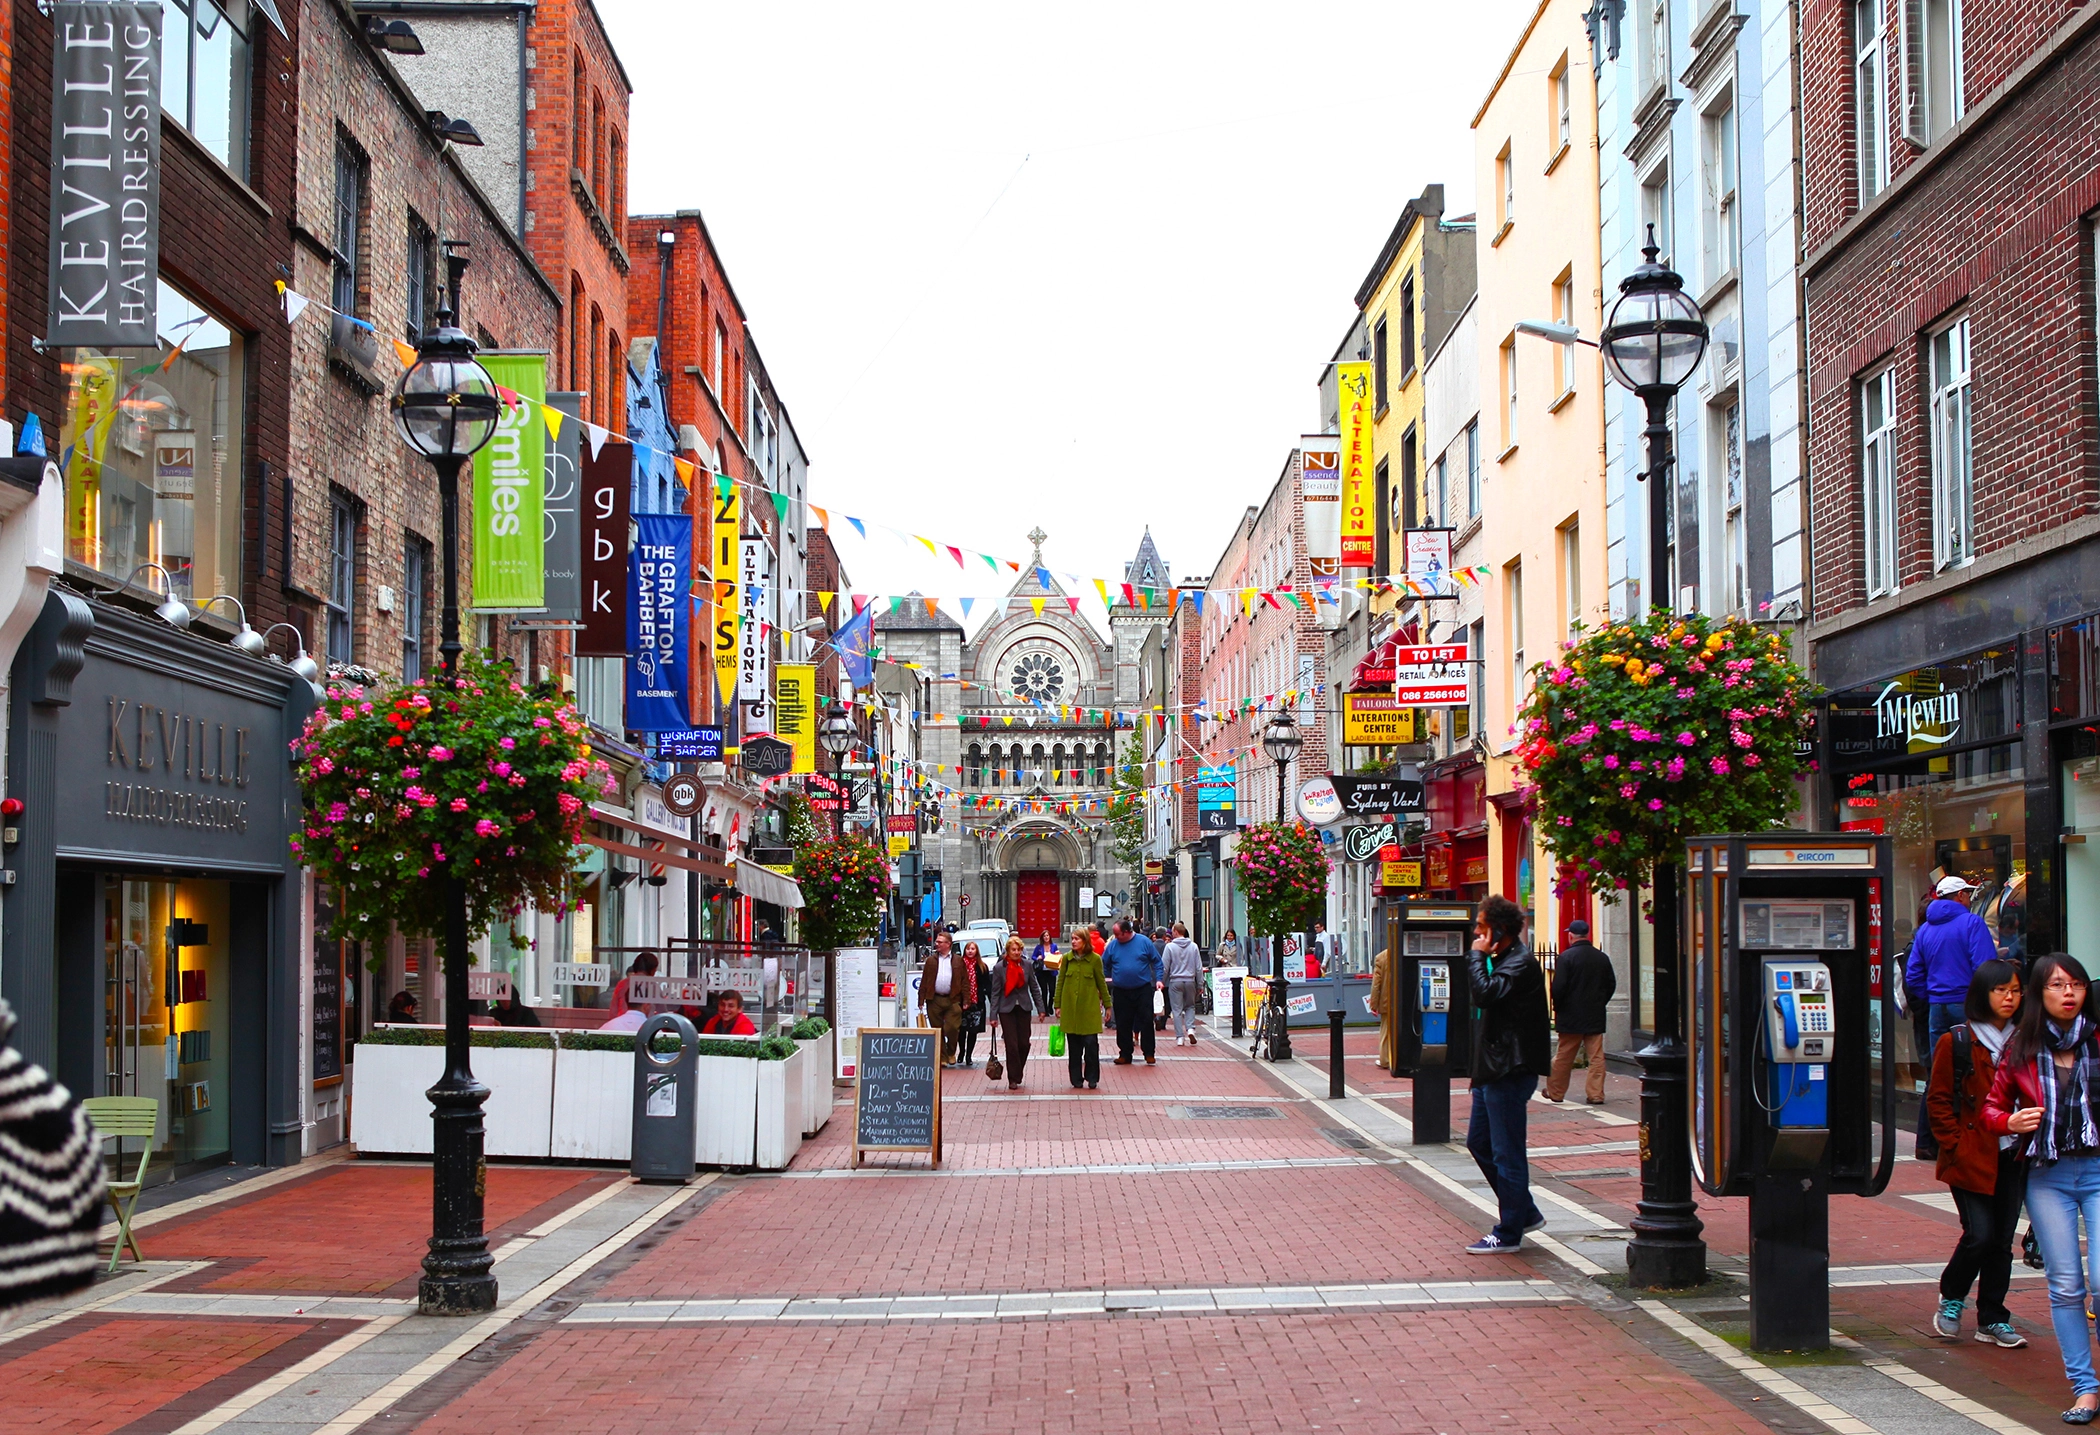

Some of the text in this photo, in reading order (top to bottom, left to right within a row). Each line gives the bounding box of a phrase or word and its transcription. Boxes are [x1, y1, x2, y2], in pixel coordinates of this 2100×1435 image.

[58, 22, 114, 326] KEVILLE
[119, 24, 151, 326] HAIRDRESSING
[1306, 452, 1338, 471] NU
[1350, 402, 1364, 530] ALTERATION
[1304, 471, 1339, 480] Essence
[1304, 481, 1339, 492] Beauty
[641, 545, 675, 559] THE
[1343, 540, 1372, 552] CENTRE
[552, 568, 575, 579] body
[639, 562, 655, 649] BARBER
[658, 562, 676, 664] GRAFTON
[715, 655, 737, 668] HEMS
[1411, 648, 1455, 661] TO LET
[1365, 669, 1396, 680] RESTAU
[1399, 671, 1425, 680] RETAIL
[637, 690, 678, 698] BASEMENT
[1402, 690, 1421, 700] 086
[1423, 689, 1466, 700] 2566106
[778, 678, 810, 735] GOTHAM
[1356, 700, 1396, 708] TAILORIN
[1351, 713, 1410, 723] ALTERATIONS
[1363, 724, 1397, 733] CENTRE
[109, 694, 250, 785] KEVILLE
[672, 730, 721, 742] GRAFTON
[660, 733, 672, 755] THE
[744, 744, 789, 771] EAT
[674, 787, 694, 801] gbk
[106, 781, 249, 832] HAIRDRESSING
[1346, 791, 1422, 813] Sydney Vard
[1345, 823, 1398, 861] Cave
[1383, 852, 1398, 860] BAR
[634, 981, 701, 1000] KITCHEN
[870, 1038, 927, 1054] KITCHEN
[862, 1063, 893, 1080] LUNCH
[896, 1062, 935, 1080] SERVED
[867, 1101, 931, 1115] DAILY SPECIALS
[866, 1115, 928, 1126] STEAK SANDWICH
